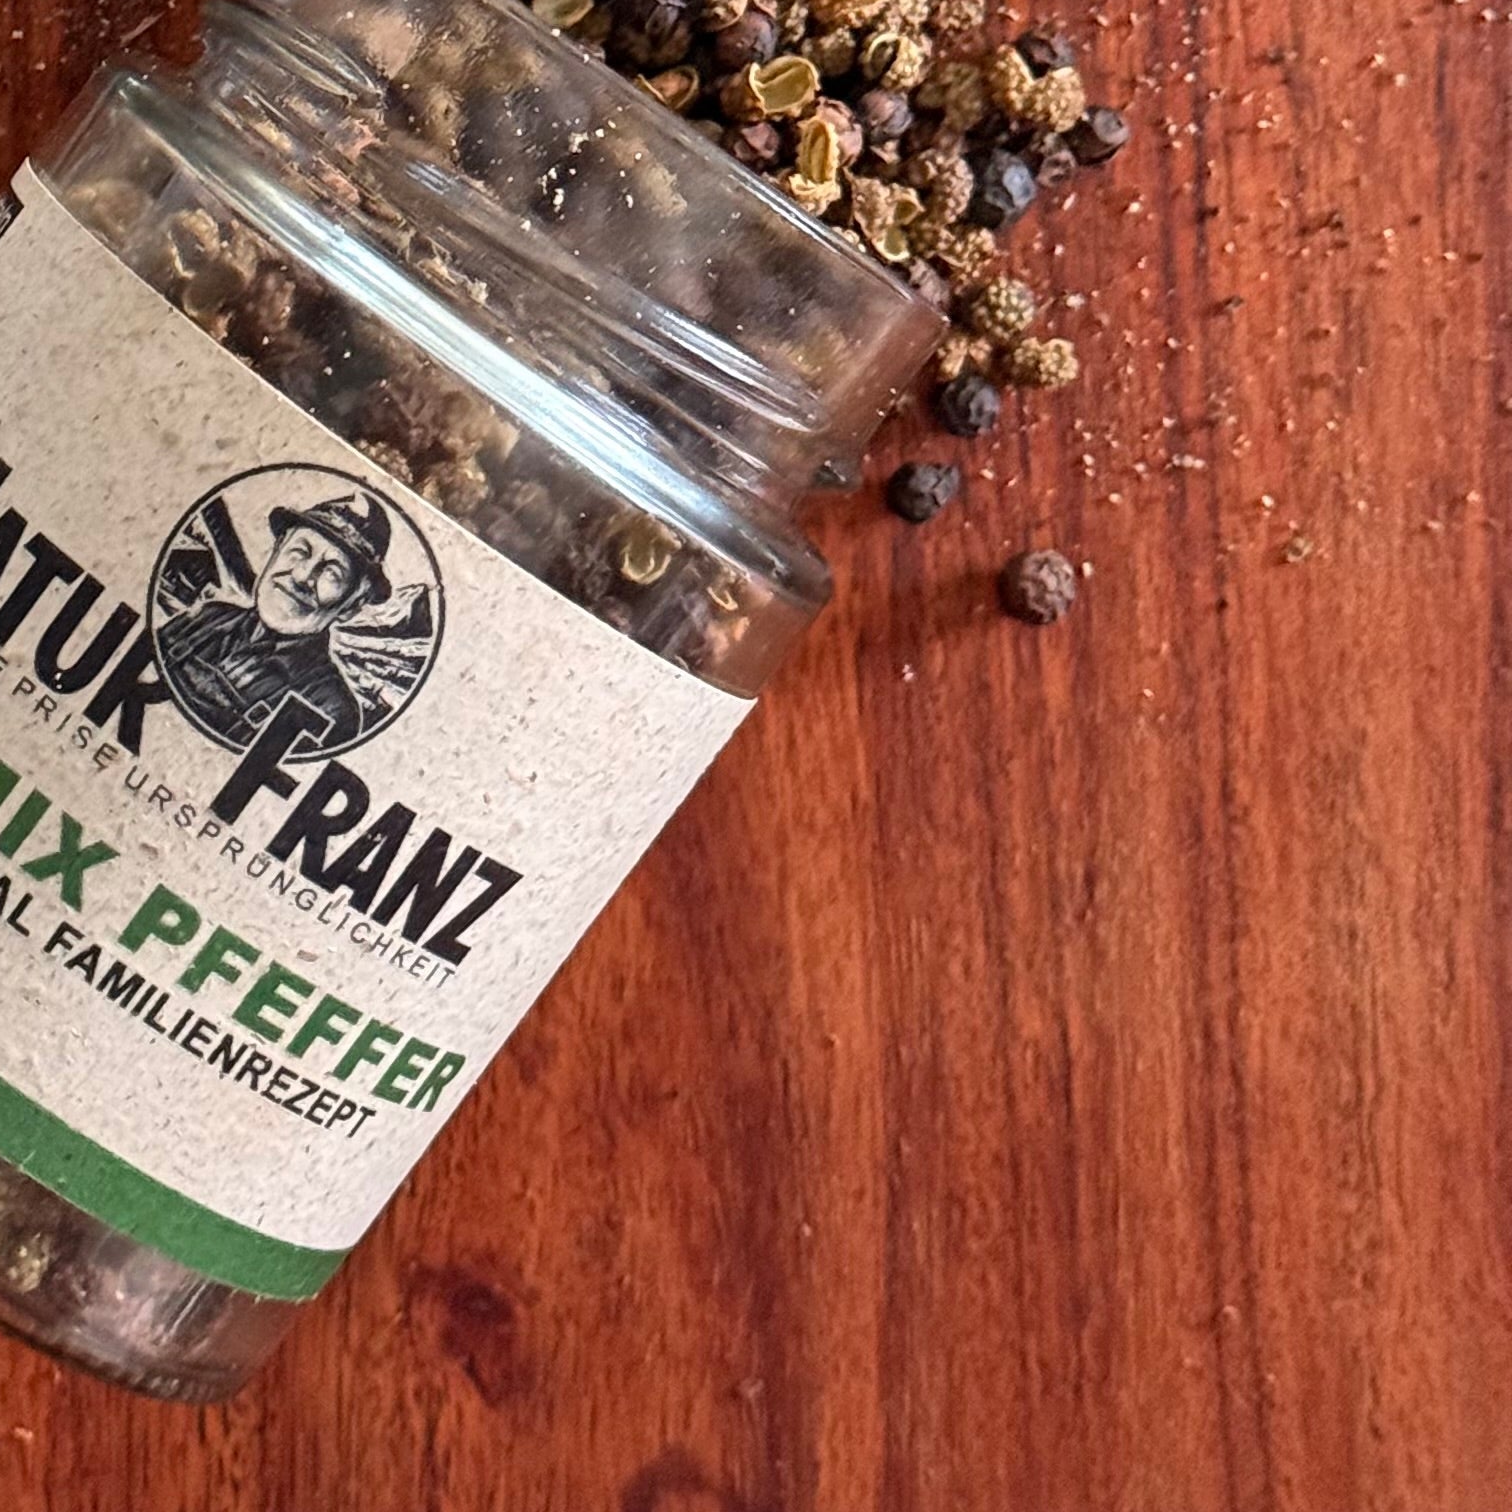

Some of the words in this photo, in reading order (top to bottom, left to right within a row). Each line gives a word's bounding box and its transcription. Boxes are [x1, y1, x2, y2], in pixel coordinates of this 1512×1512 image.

[13, 677, 120, 767] PRISE
[125, 766, 456, 988] URSPRÜNGLICHKEIT
[210, 691, 523, 965] FRANZ
[44, 922, 376, 1140] FAMILIENREZEPT
[118, 883, 466, 1112] PFEFFER
